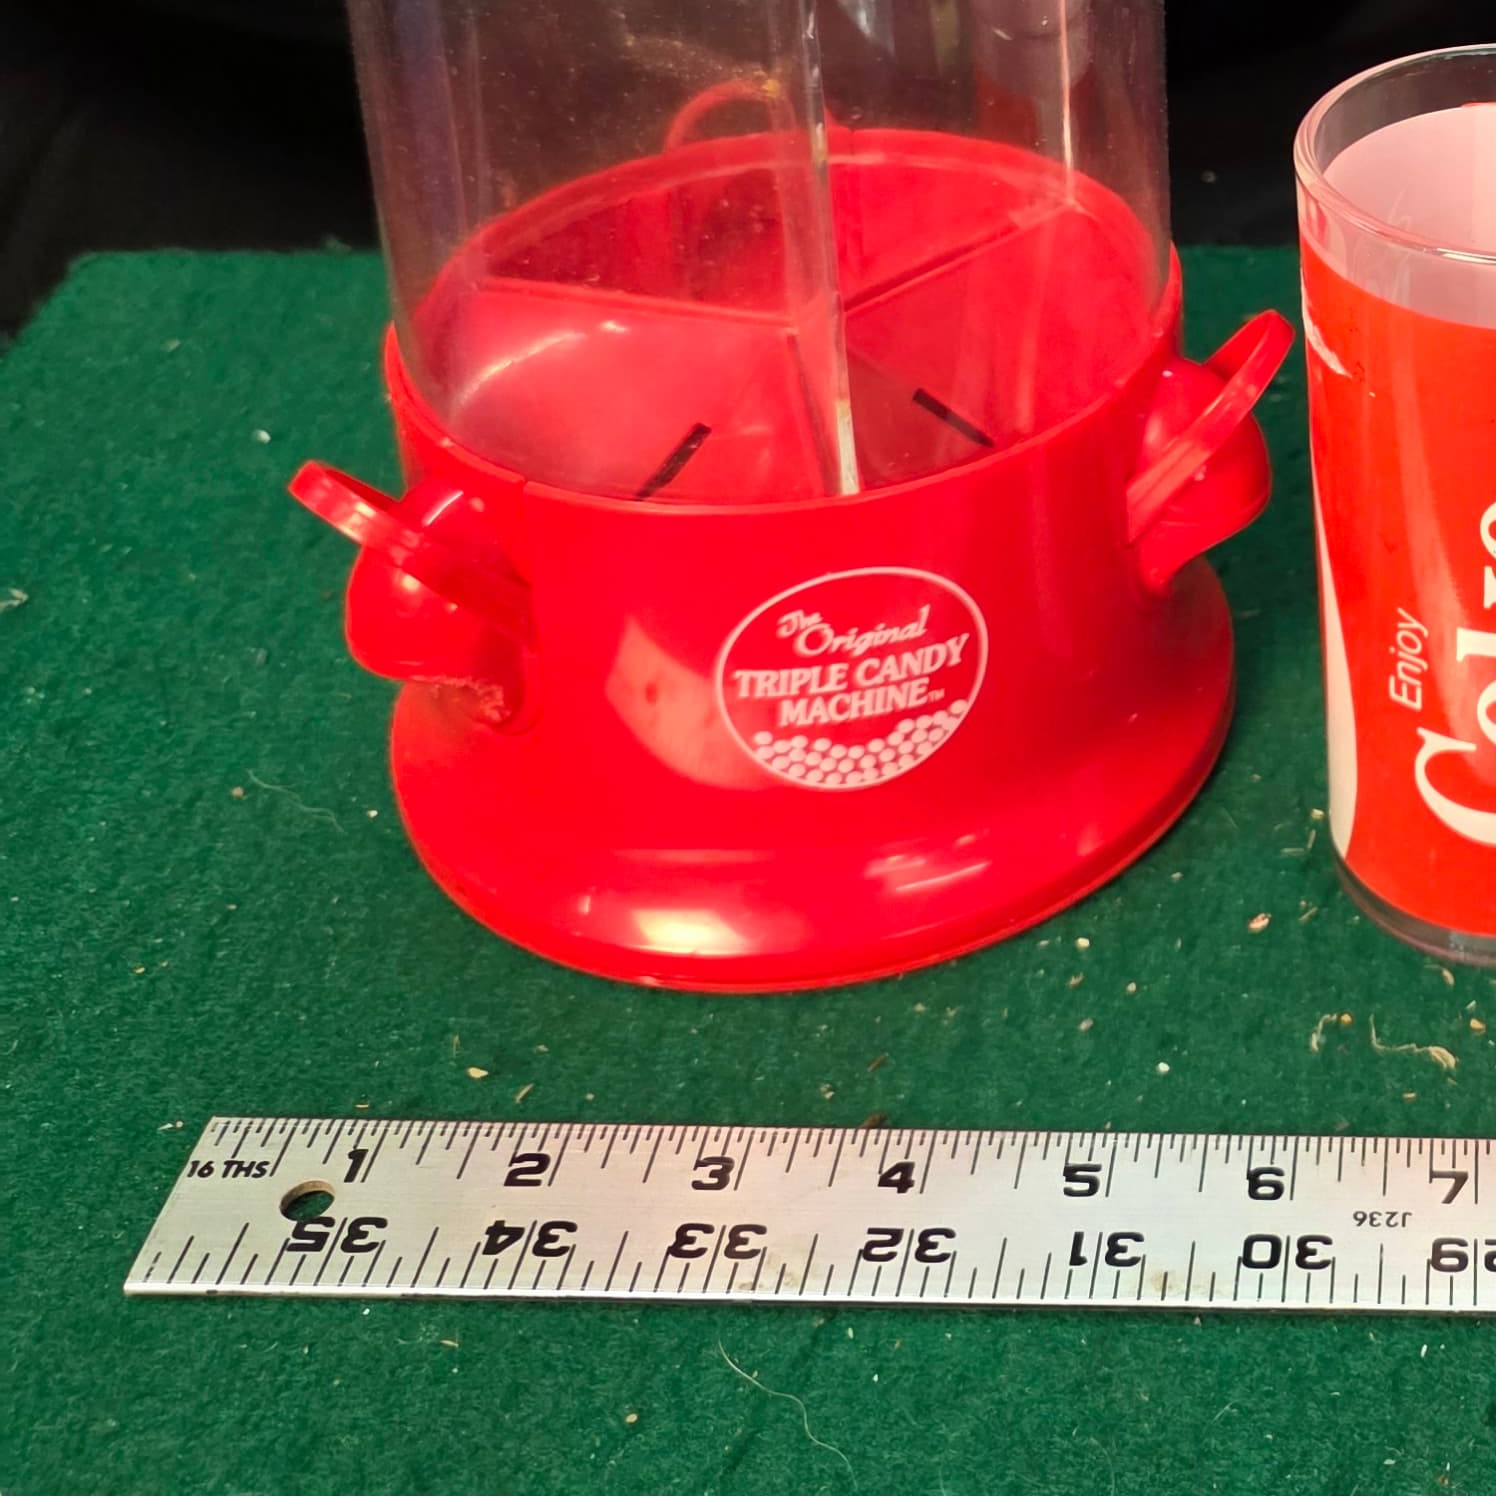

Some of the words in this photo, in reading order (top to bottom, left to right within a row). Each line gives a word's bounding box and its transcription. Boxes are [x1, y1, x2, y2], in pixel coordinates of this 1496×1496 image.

[776, 609, 822, 638] The
[794, 604, 930, 657] Original
[733, 662, 849, 697] TRIPLE
[856, 633, 970, 686] CANDY
[1389, 608, 1428, 712] Enjoy
[779, 677, 930, 727] MACHINE
[186, 1159, 215, 1179] 16
[221, 1159, 272, 1180] THS
[343, 1148, 370, 1183] 1
[503, 1152, 552, 1187] 2
[691, 1156, 735, 1191] 3
[877, 1160, 916, 1194] 4
[1062, 1163, 1101, 1198] 5
[1246, 1166, 1285, 1201] 6
[1430, 1169, 1469, 1205] 7
[287, 1217, 388, 1253] 35
[483, 1219, 578, 1258] 34
[1351, 1211, 1413, 1229] J236
[668, 1222, 769, 1259] 33
[862, 1227, 956, 1263] 32
[1068, 1230, 1145, 1267] 31
[1242, 1234, 1333, 1270] 30
